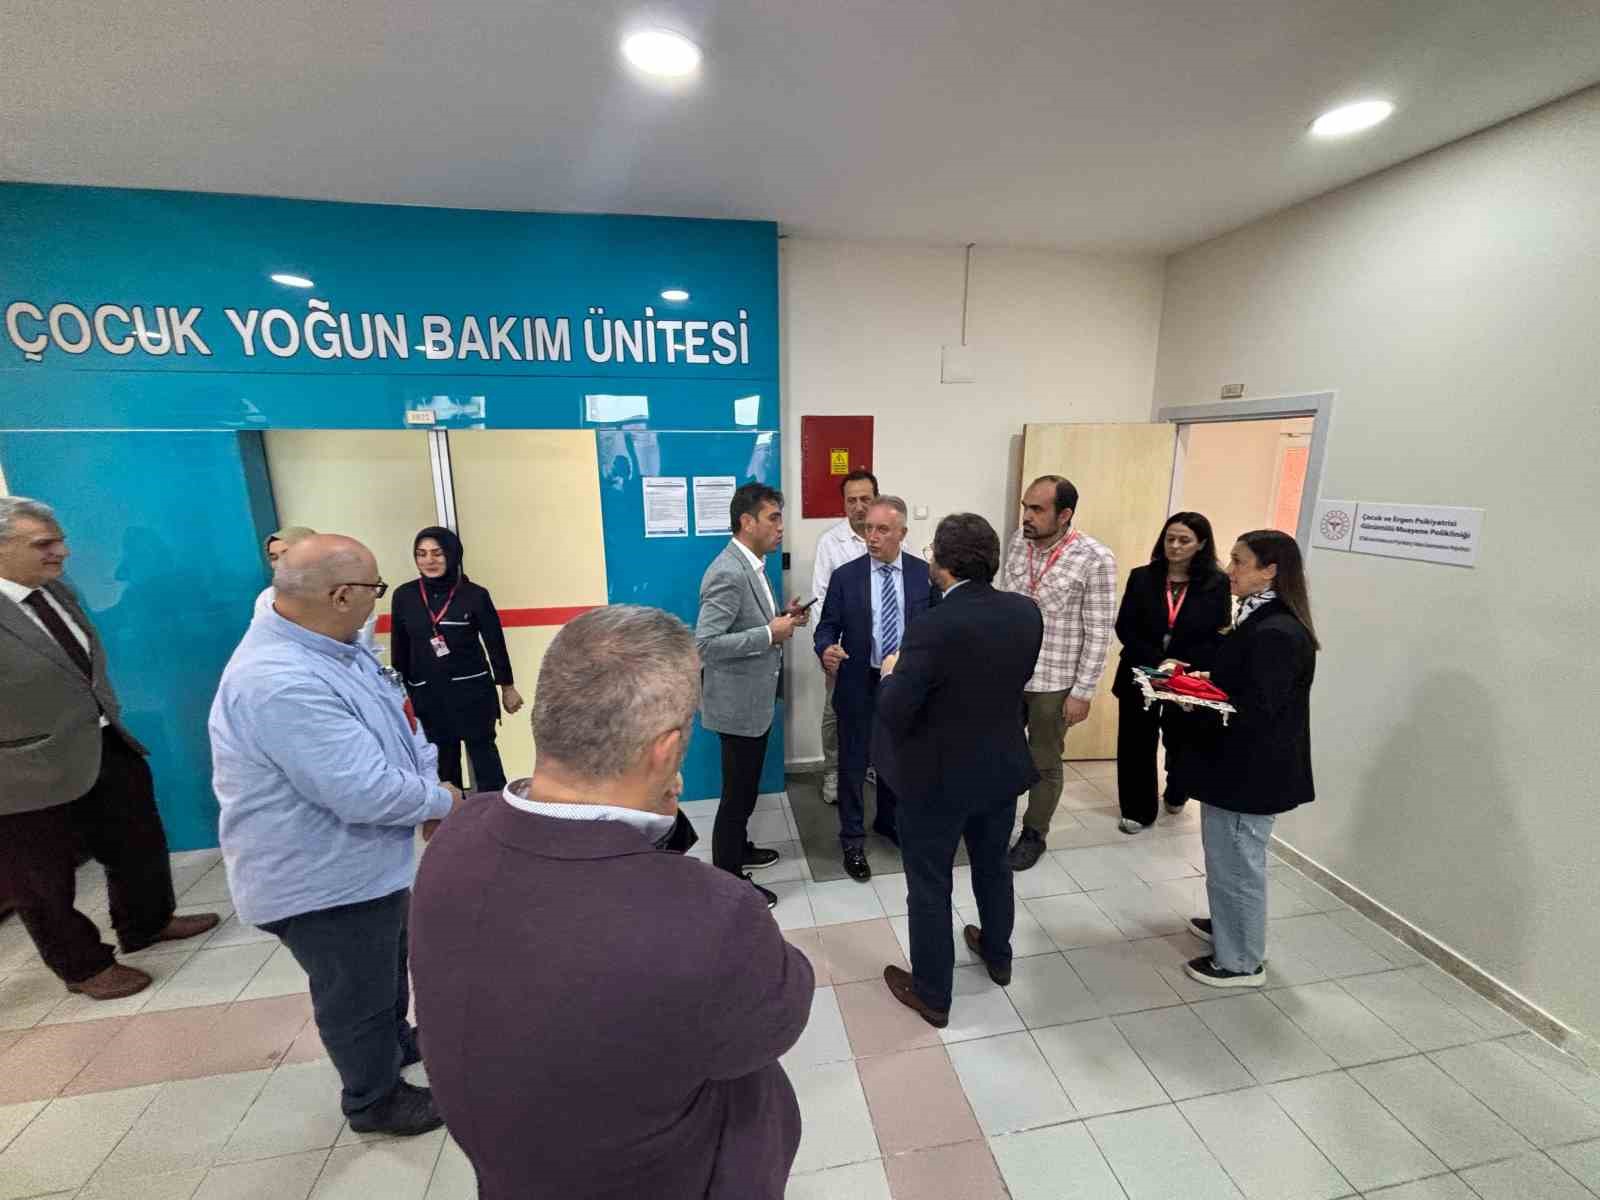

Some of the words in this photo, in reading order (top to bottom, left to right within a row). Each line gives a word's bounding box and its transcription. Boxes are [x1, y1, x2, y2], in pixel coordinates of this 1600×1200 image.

[5, 300, 212, 362] ÇOCUK
[224, 298, 407, 360] YOĞUN
[421, 314, 572, 362] BAKIM
[583, 306, 750, 366] ÜNİTESİ
